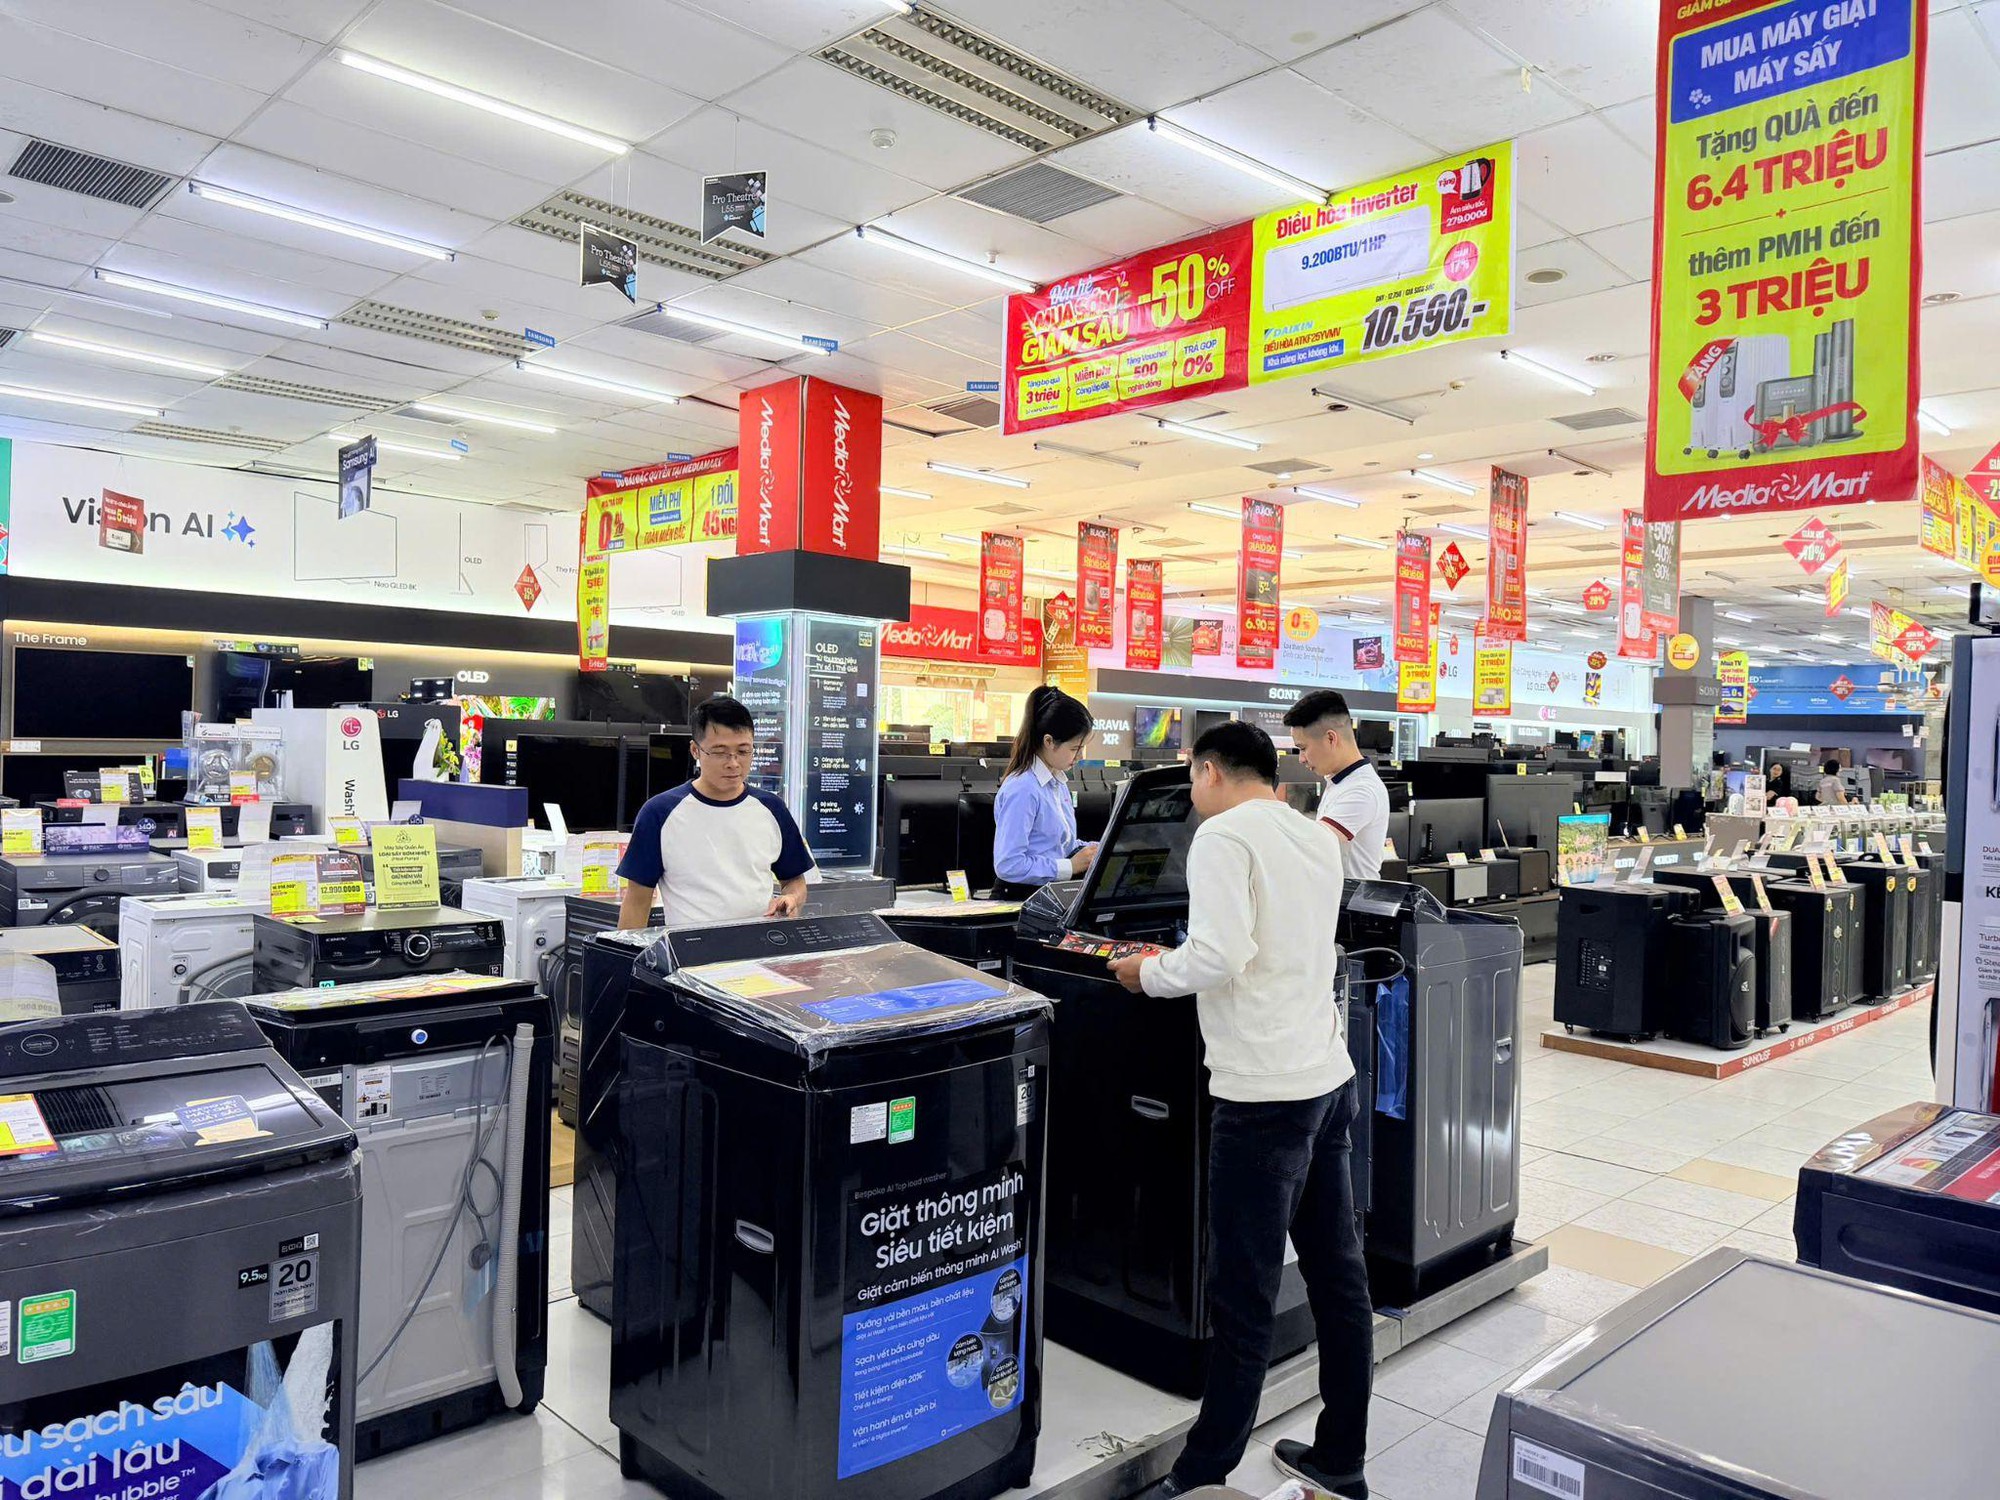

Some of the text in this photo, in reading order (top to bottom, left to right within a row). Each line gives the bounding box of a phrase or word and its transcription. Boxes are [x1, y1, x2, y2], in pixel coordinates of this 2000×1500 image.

[1702, 36, 1752, 69] MUA
[1761, 12, 1818, 50] MÁY
[1734, 37, 1842, 94] MÁY SẤY
[1696, 86, 1878, 162] Tặng QUÀ đến
[1686, 127, 1888, 212] 6.4 TRIỆU
[712, 192, 757, 204] Pro Theatre
[1276, 183, 1418, 239] Điều hòa inverter
[1446, 208, 1488, 227] 279.000đ
[1301, 234, 1386, 270] 9.200BTU/1HP
[1689, 210, 1880, 277] thêm PMH đến
[591, 245, 631, 266] Pro Theatre
[1207, 277, 1236, 300] OFF
[1695, 256, 1869, 325] 3 TRIỆU
[527, 331, 553, 345] SAMSUNG
[1133, 362, 1158, 379] 500
[1182, 353, 1213, 377] 0%
[1074, 366, 1095, 383] Miễn
[970, 383, 999, 391] SAMSUNG
[1026, 387, 1060, 404] 3 triệu
[1127, 382, 1145, 393] nghìn
[343, 453, 368, 470] Samsung
[759, 397, 774, 547] Media Mart
[832, 394, 850, 549] Media Mart
[650, 487, 682, 512] MIỄN PHÍ
[1681, 471, 1872, 511] Media Mart
[182, 512, 213, 538] AI
[599, 511, 612, 550] 0
[1090, 528, 1110, 539] BLACK
[994, 538, 1016, 548] BLACK
[464, 557, 482, 565] OLED
[556, 566, 567, 574] The
[374, 581, 388, 589] Neo
[390, 582, 408, 590] QLED
[1080, 622, 1104, 635] 4.990
[14, 632, 87, 646] The Frame
[938, 630, 973, 650] Mart
[816, 643, 838, 654] OLED
[1128, 648, 1149, 658] 4.990
[457, 671, 489, 683] OLED
[1448, 666, 1458, 677] LG
[1721, 674, 1745, 683] 3 triệu
[816, 679, 820, 688] 1
[1699, 686, 1719, 695] SONY
[1269, 688, 1301, 700] SONY
[387, 710, 399, 718] LG
[814, 717, 820, 726] 2
[1546, 710, 1556, 720] LG
[1092, 719, 1130, 731] BRAVIA
[343, 740, 360, 751] LG
[1102, 733, 1119, 745] XR
[813, 757, 819, 767] 3
[812, 802, 818, 811] 4
[167, 829, 177, 838] AI
[1021, 1086, 1032, 1099] 20
[854, 1172, 947, 1200] Bespoke AI Top load washer
[860, 1172, 1023, 1238] Giặt thông minh
[875, 1211, 1014, 1269] Siêu tiết kiệm
[240, 1270, 267, 1283] 9.5kg
[279, 1259, 311, 1287] 20
[858, 1248, 999, 1303] Giặt cảm biến thông minh AI
[856, 1287, 974, 1331] Dưỡng vải bền bền chất liệu
[854, 1354, 875, 1367] Sạch
[877, 1347, 890, 1359] vết
[891, 1343, 906, 1355] bẩn
[854, 1377, 907, 1401] Tiết kiệm điện
[40, 1381, 224, 1453] sạch sâu
[853, 1426, 868, 1437] Vận
[870, 1419, 889, 1431] hành
[914, 1404, 928, 1415] bền
[21, 1437, 180, 1500] dài lâu
